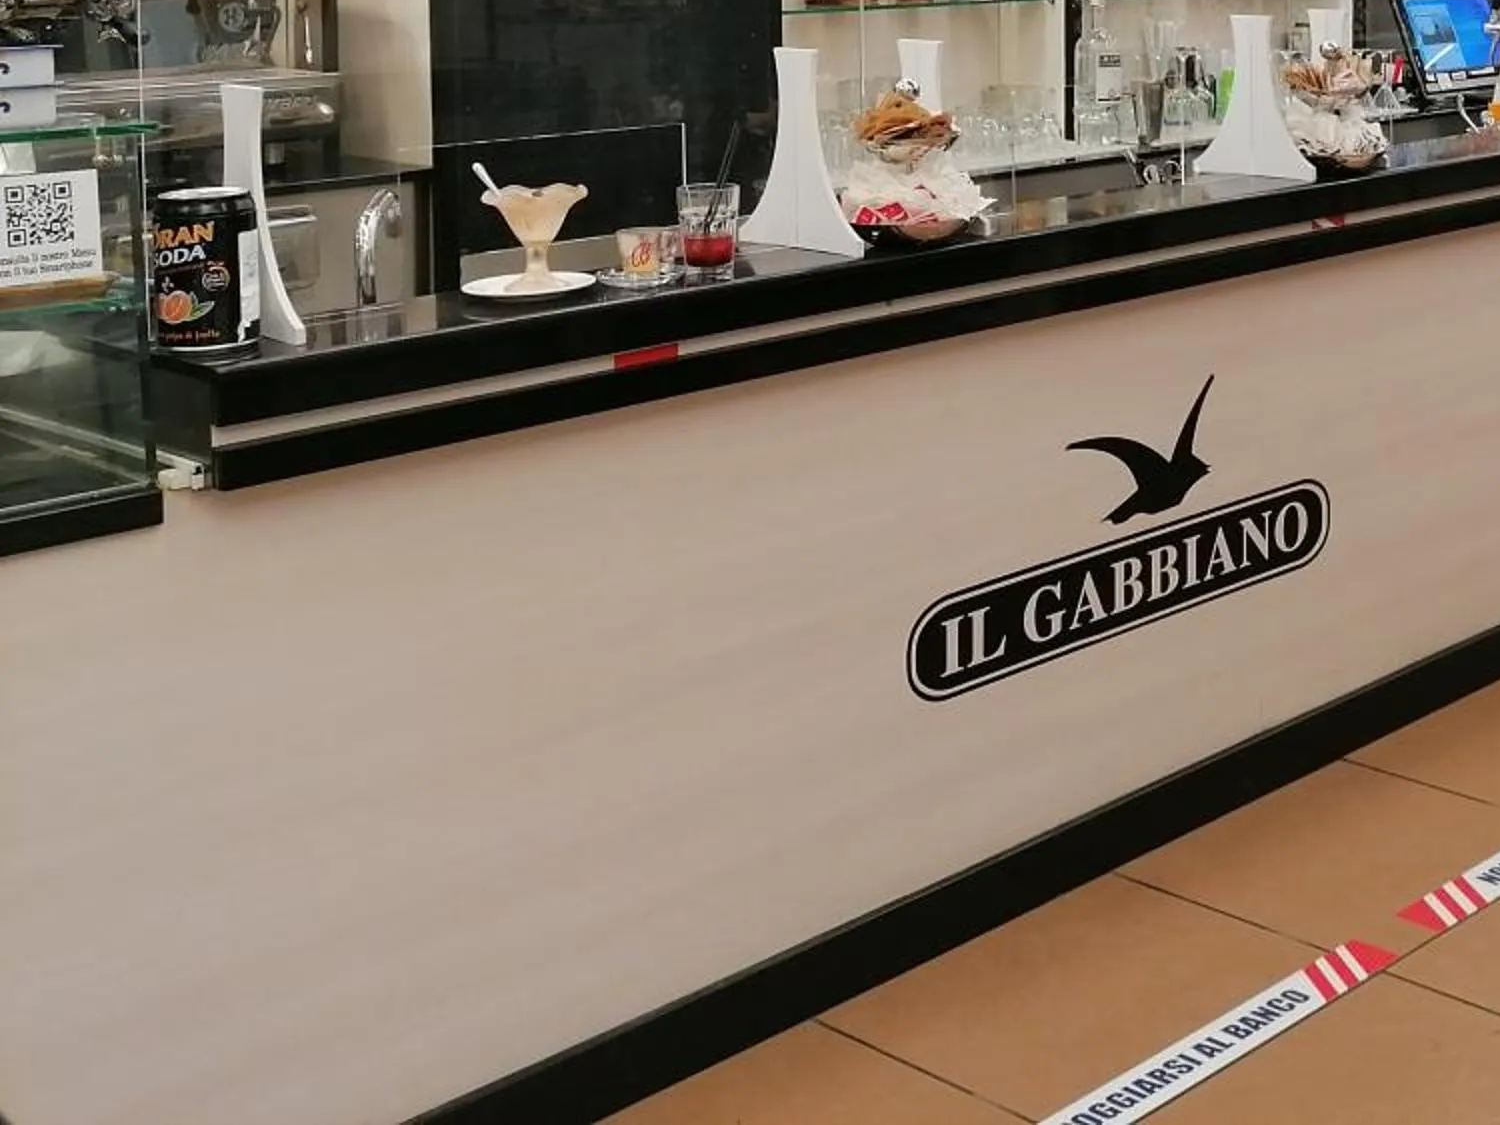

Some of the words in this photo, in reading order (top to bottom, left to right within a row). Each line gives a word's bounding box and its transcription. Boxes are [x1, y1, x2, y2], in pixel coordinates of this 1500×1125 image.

[940, 605, 1007, 678] IL
[1022, 501, 1309, 644] GABBIANO
[1061, 1054, 1203, 1125] OGGIARSI
[1192, 1036, 1235, 1060] AL
[1221, 989, 1311, 1040] BANCO
